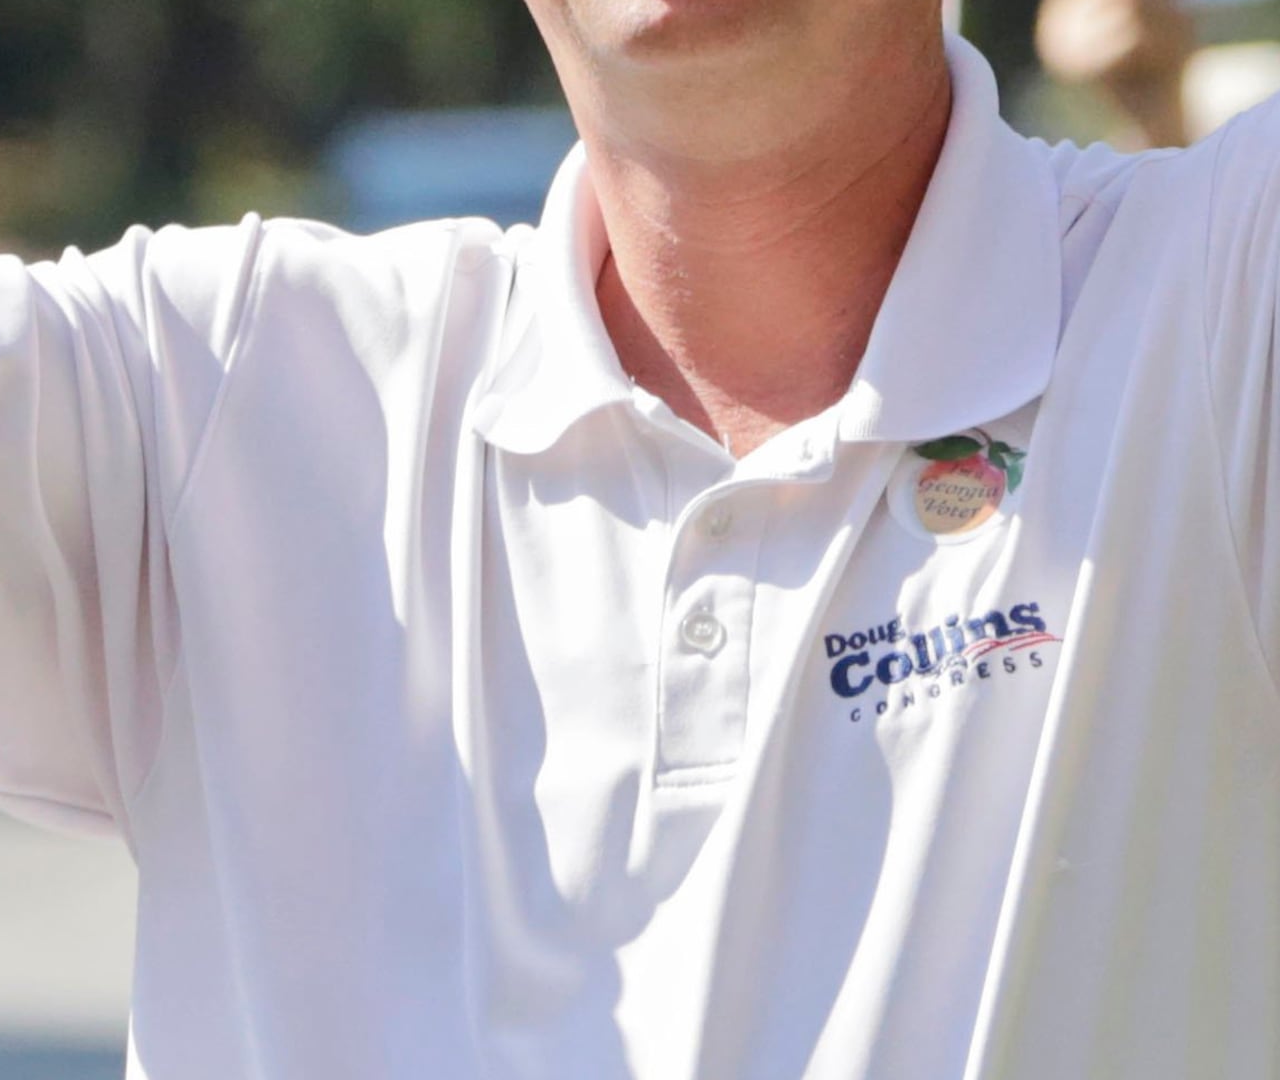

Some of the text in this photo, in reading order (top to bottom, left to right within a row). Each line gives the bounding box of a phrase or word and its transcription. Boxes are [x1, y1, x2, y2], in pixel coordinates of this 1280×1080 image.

[918, 477, 1000, 502] Georgia
[923, 497, 983, 519] Voter
[824, 614, 906, 659] Doug
[830, 602, 1047, 698] Collins
[850, 651, 1043, 722] CONGRESS
